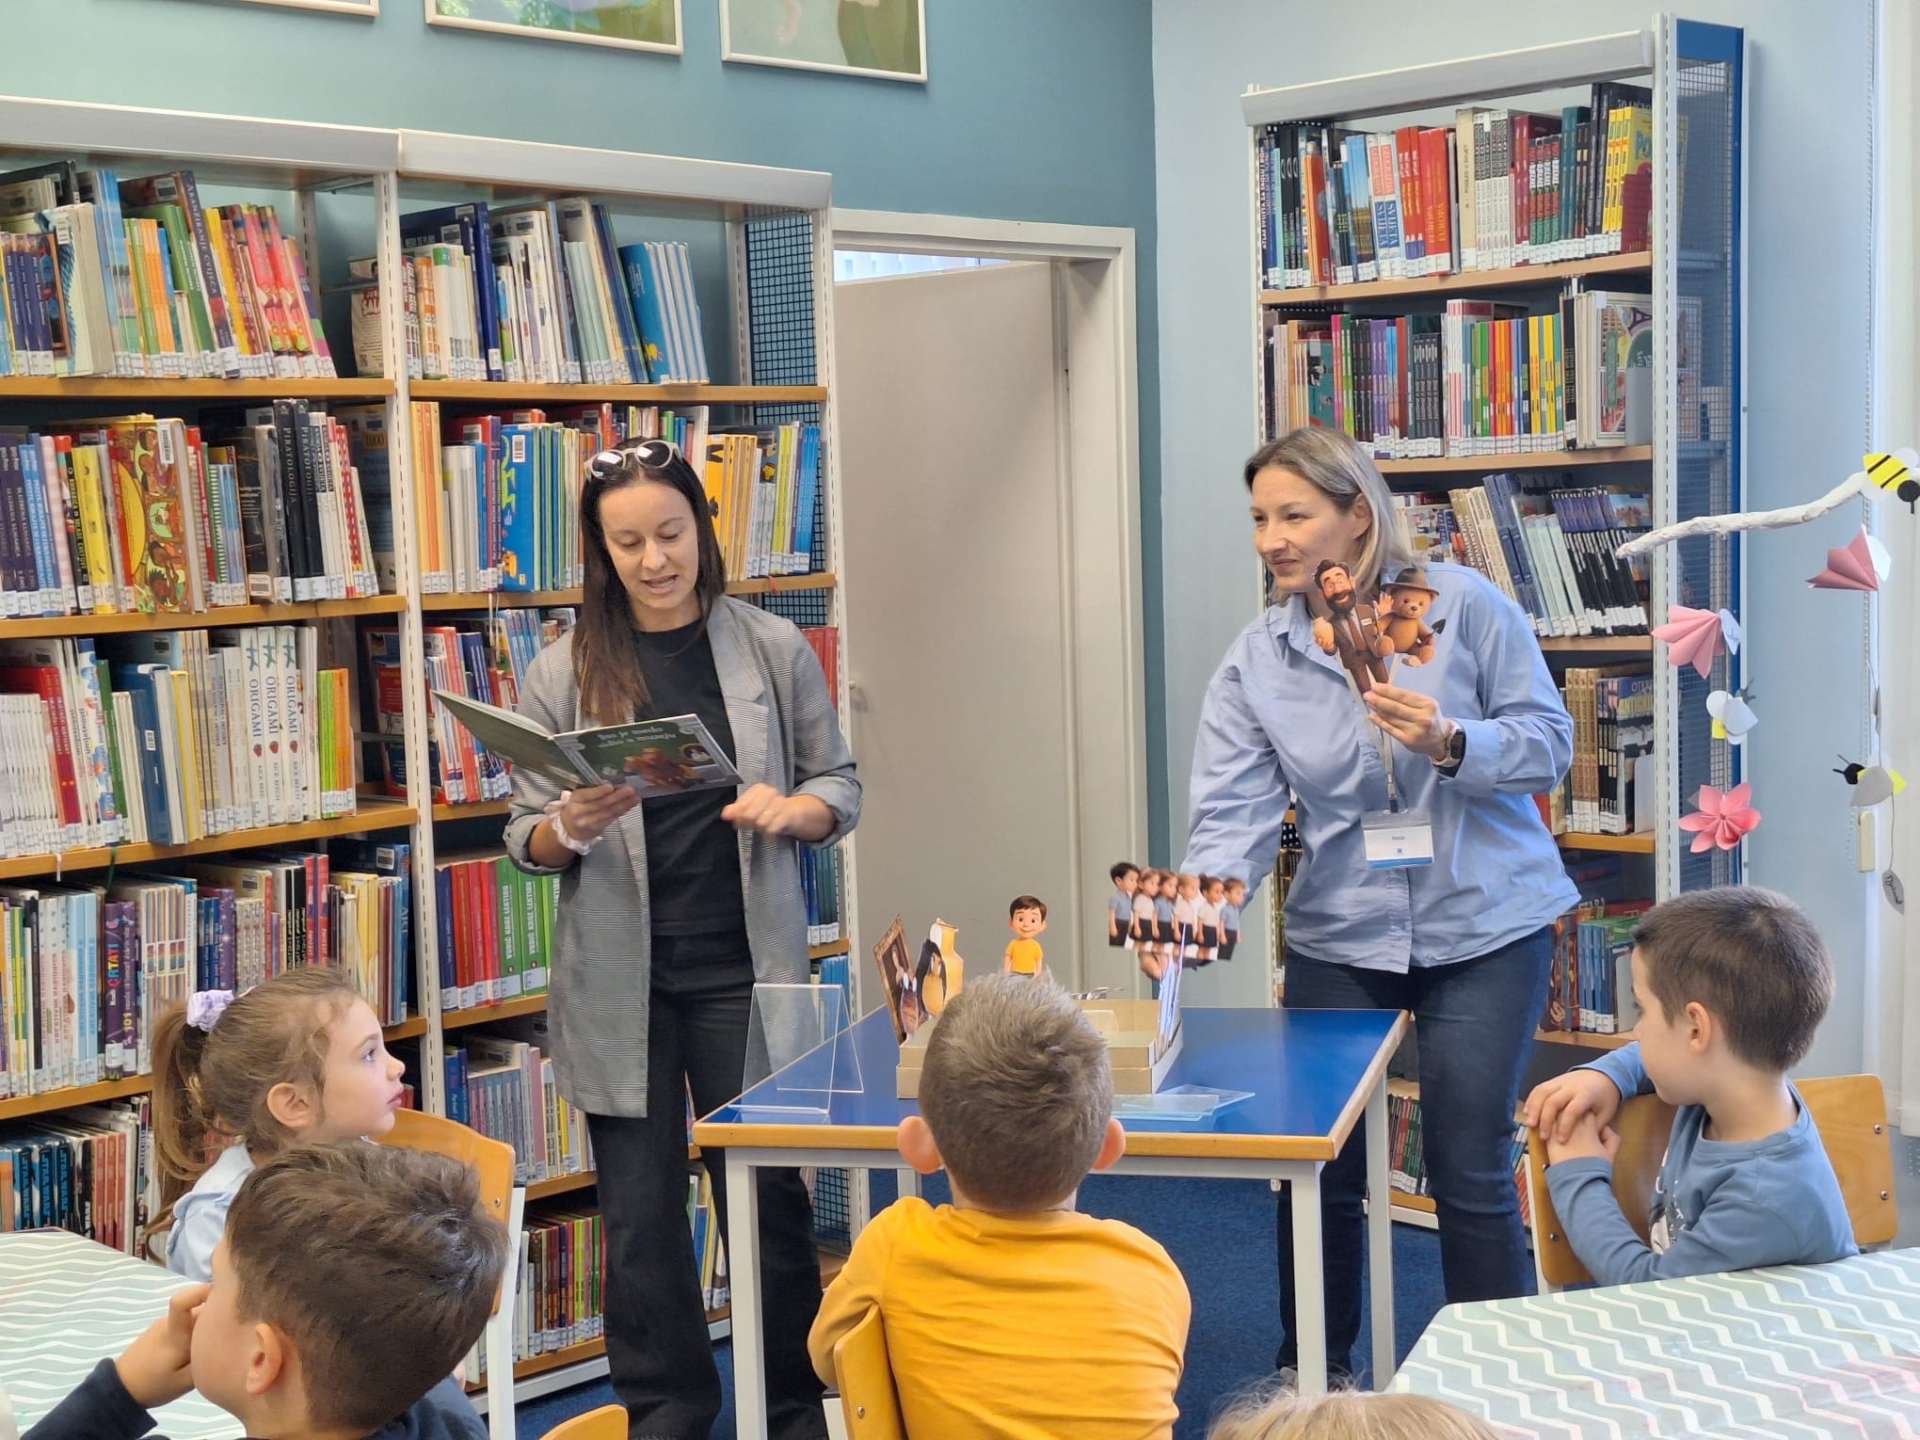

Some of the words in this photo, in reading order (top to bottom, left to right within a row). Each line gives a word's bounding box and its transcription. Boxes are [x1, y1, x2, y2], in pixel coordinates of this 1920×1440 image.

[283, 427, 296, 502] PIRATOLOGIJA
[301, 426, 313, 502] PIRATOLOGIJA
[249, 678, 262, 737] ORIGAMI
[265, 676, 279, 735] ORIGAMI
[286, 675, 298, 734] ORIGAMI
